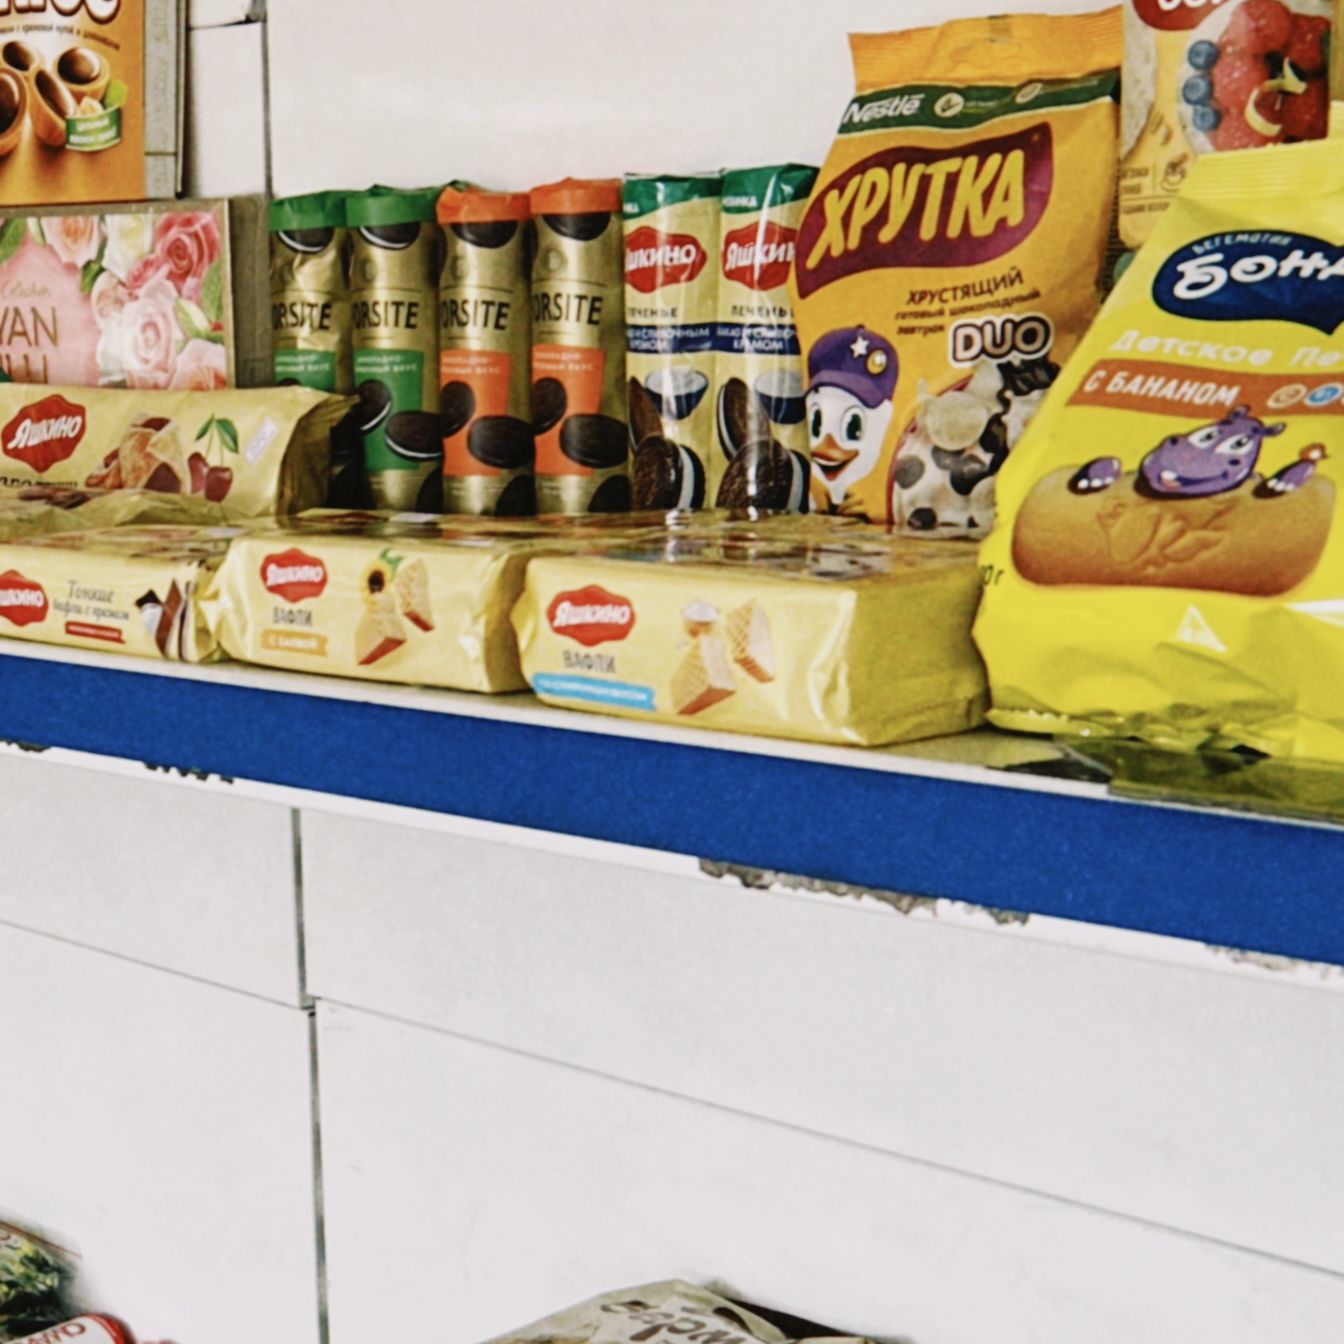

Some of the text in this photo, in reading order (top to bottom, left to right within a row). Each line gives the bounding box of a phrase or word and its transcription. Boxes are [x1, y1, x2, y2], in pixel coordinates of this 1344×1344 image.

[805, 148, 1025, 271] ХРУТКА
[626, 238, 697, 268] шкино
[905, 266, 1024, 306] ХРУСТЯЩИЙ
[954, 315, 1048, 363] DUO
[1111, 330, 1274, 369] Детское
[1082, 370, 1242, 408] С БАНАНОМ
